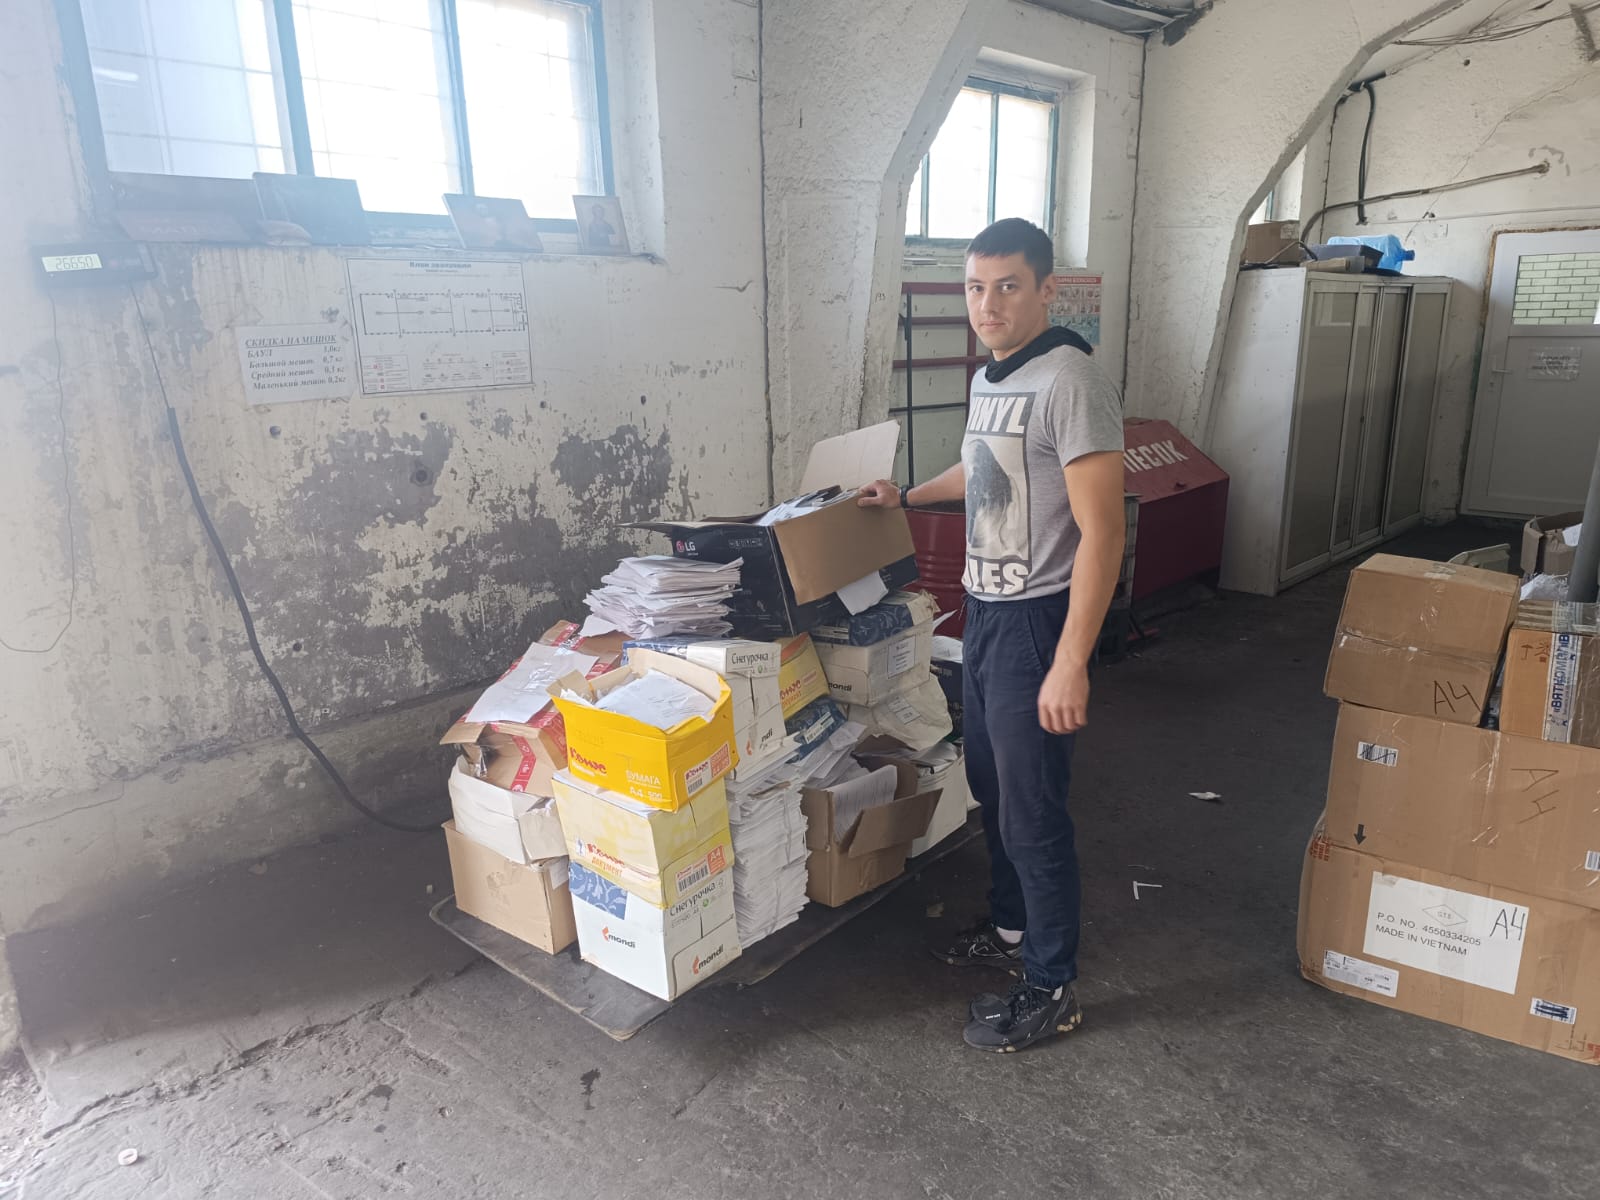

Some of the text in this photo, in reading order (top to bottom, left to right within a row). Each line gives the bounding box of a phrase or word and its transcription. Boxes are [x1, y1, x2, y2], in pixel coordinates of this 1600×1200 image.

[55, 256, 95, 271] 26650
[245, 334, 337, 348] СКИДКА НА МЕШОК
[247, 349, 273, 359] БАУЛ
[249, 359, 287, 369] Большой
[251, 369, 287, 380] Средний
[252, 380, 299, 391] Маленький
[684, 541, 697, 552] LG
[731, 652, 770, 667] Снегурочка
[669, 881, 717, 916] Снегурочка
[608, 934, 636, 950] mondi
[1374, 924, 1468, 957] MADE IN VIETNAM
[1421, 924, 1482, 947] 4550334205
[698, 943, 725, 971] mondi
